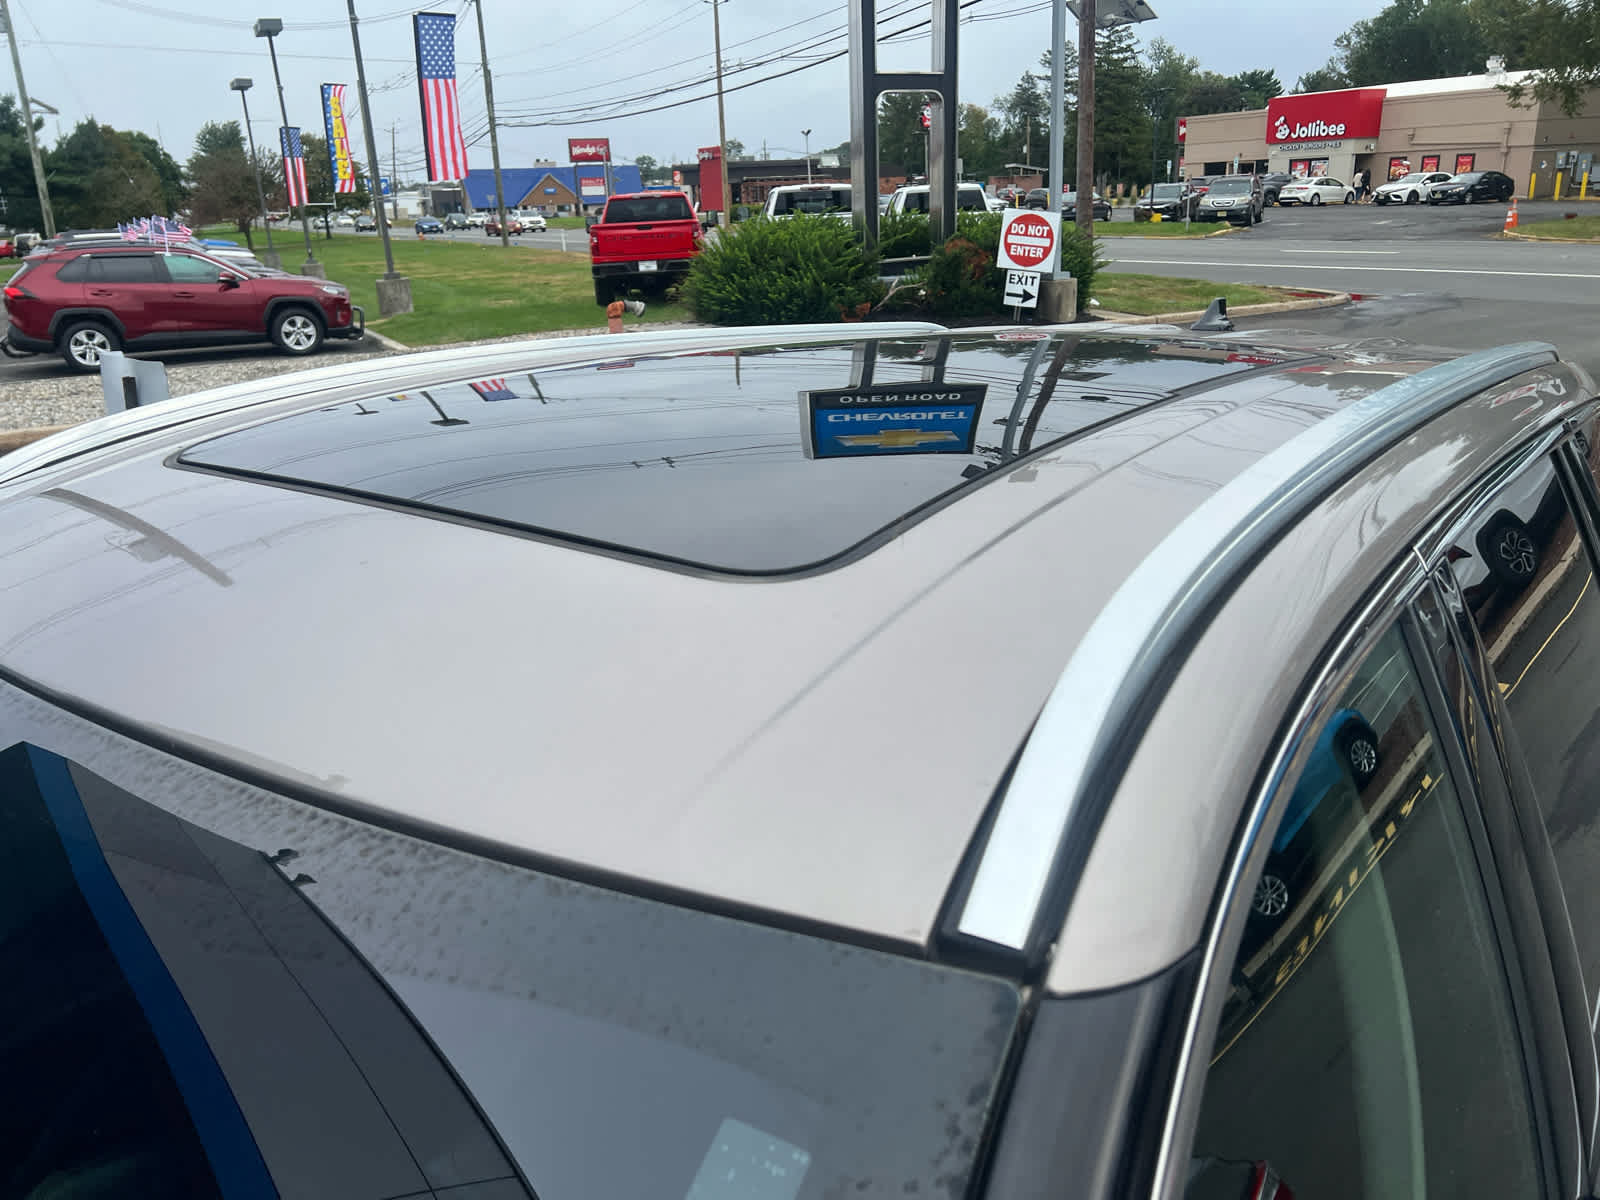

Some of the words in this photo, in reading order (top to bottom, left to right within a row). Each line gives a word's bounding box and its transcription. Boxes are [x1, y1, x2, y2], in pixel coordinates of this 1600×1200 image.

[1291, 120, 1346, 139] Jollibee
[330, 96, 351, 180] SALE
[1011, 223, 1026, 235] DO
[1027, 225, 1050, 237] NOT
[1010, 245, 1044, 259] ENTER
[1008, 273, 1037, 287] EXIT
